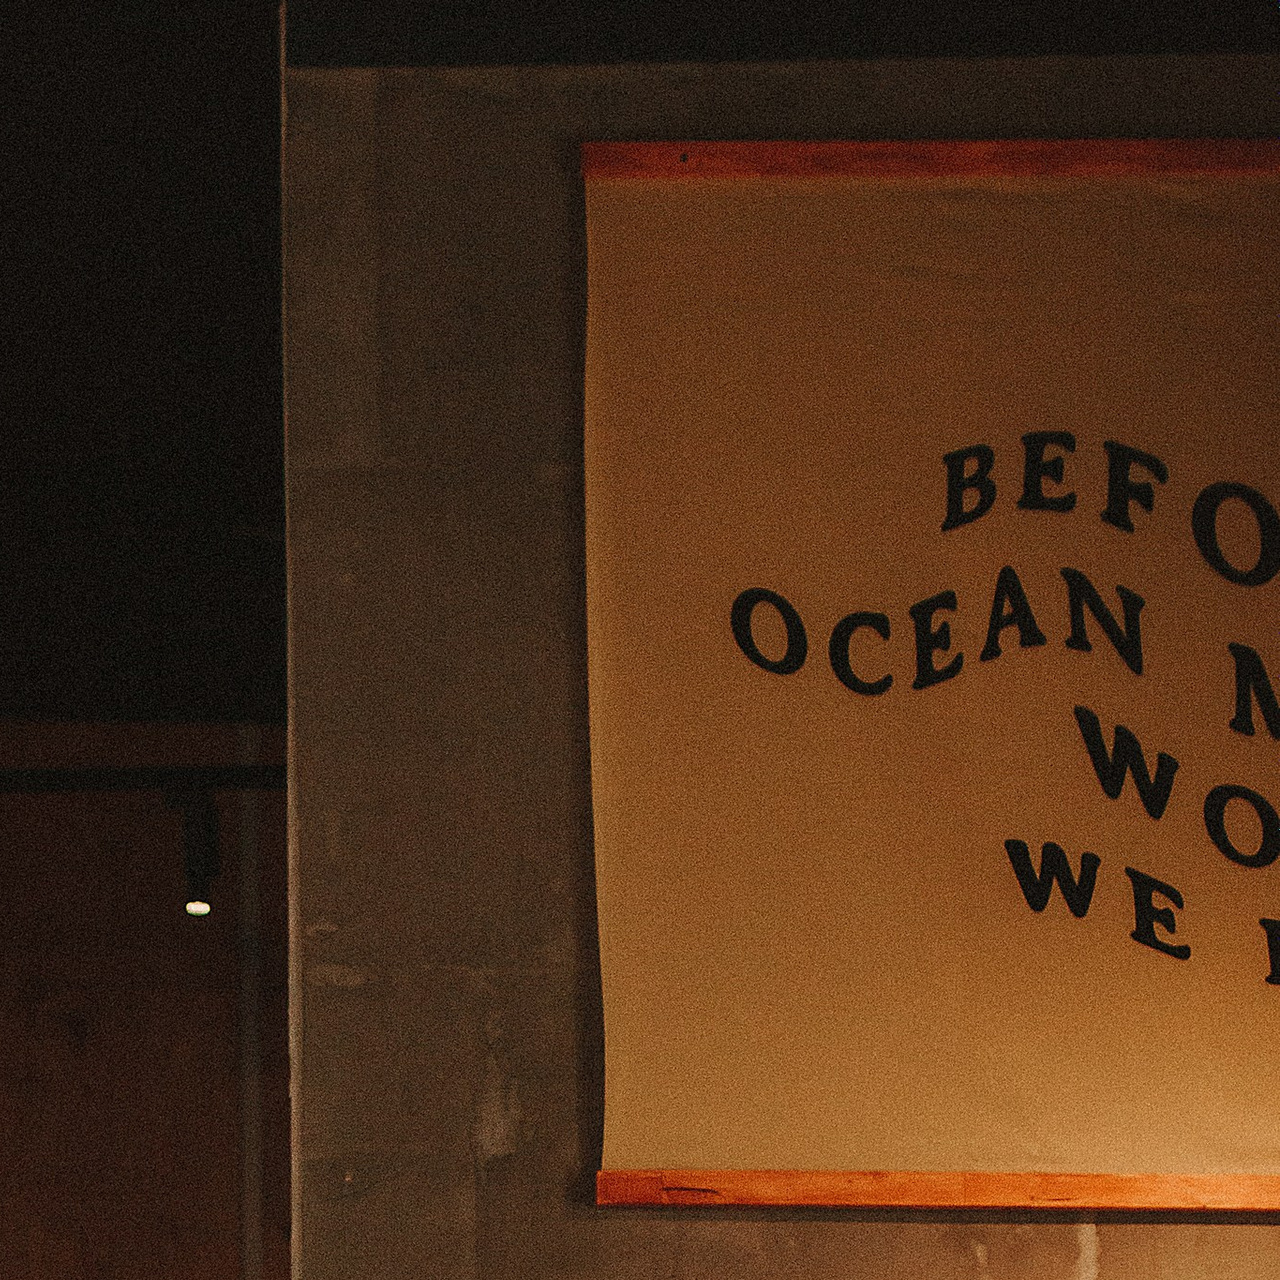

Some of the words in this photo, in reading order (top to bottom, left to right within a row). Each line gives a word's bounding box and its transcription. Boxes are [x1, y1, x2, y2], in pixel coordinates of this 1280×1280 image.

[941, 430, 1280, 590] BEFO
[730, 565, 1146, 696] OCEAN
[1004, 838, 1192, 961] WE
